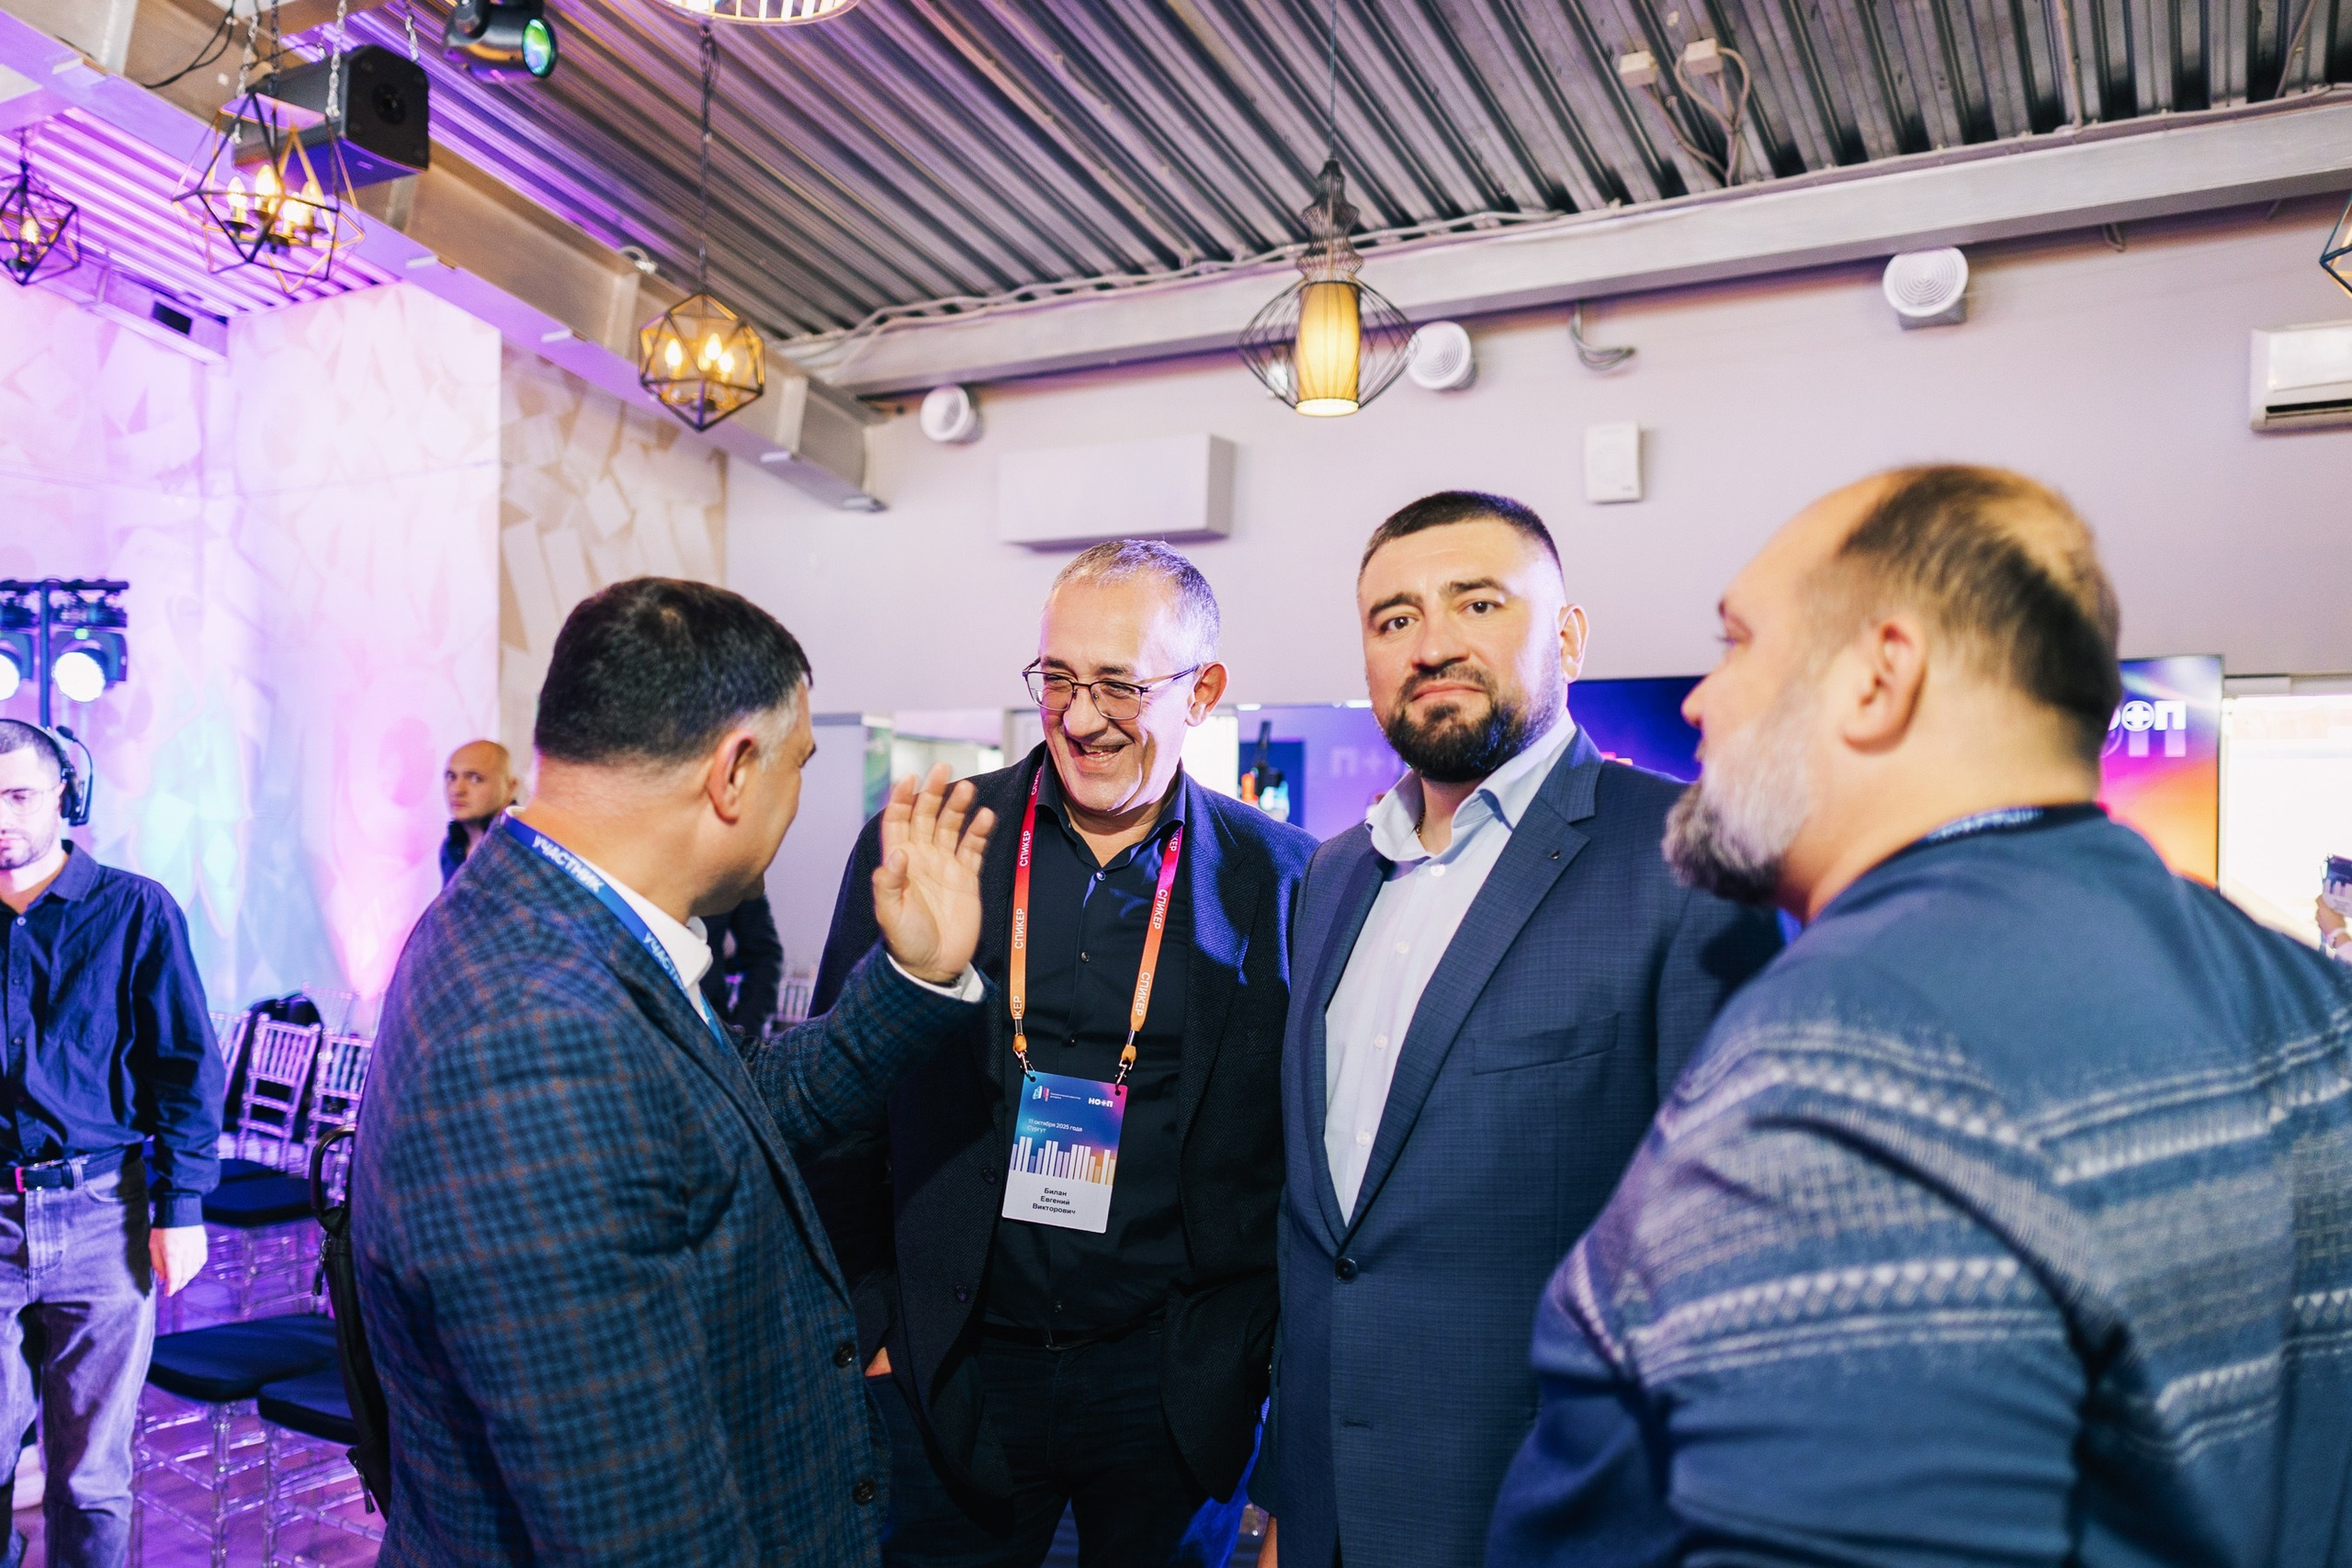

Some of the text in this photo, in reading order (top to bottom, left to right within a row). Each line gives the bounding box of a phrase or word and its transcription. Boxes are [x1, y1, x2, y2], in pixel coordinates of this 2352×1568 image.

[1020, 829, 1031, 867] СПИКЕР
[532, 835, 605, 893] УЧАСТНИК
[1153, 889, 1168, 930] СПИКЕР
[1014, 908, 1025, 949] СПИКЕР
[1135, 972, 1150, 1016] СПИКЕР
[1027, 1124, 1046, 1134] Сургут
[1034, 1120, 1056, 1128] октября
[1056, 1122, 1069, 1131] 2025
[1040, 1195, 1070, 1205] Евгений
[1044, 1187, 1068, 1197] Билан
[1032, 1202, 1076, 1214] Викторович
